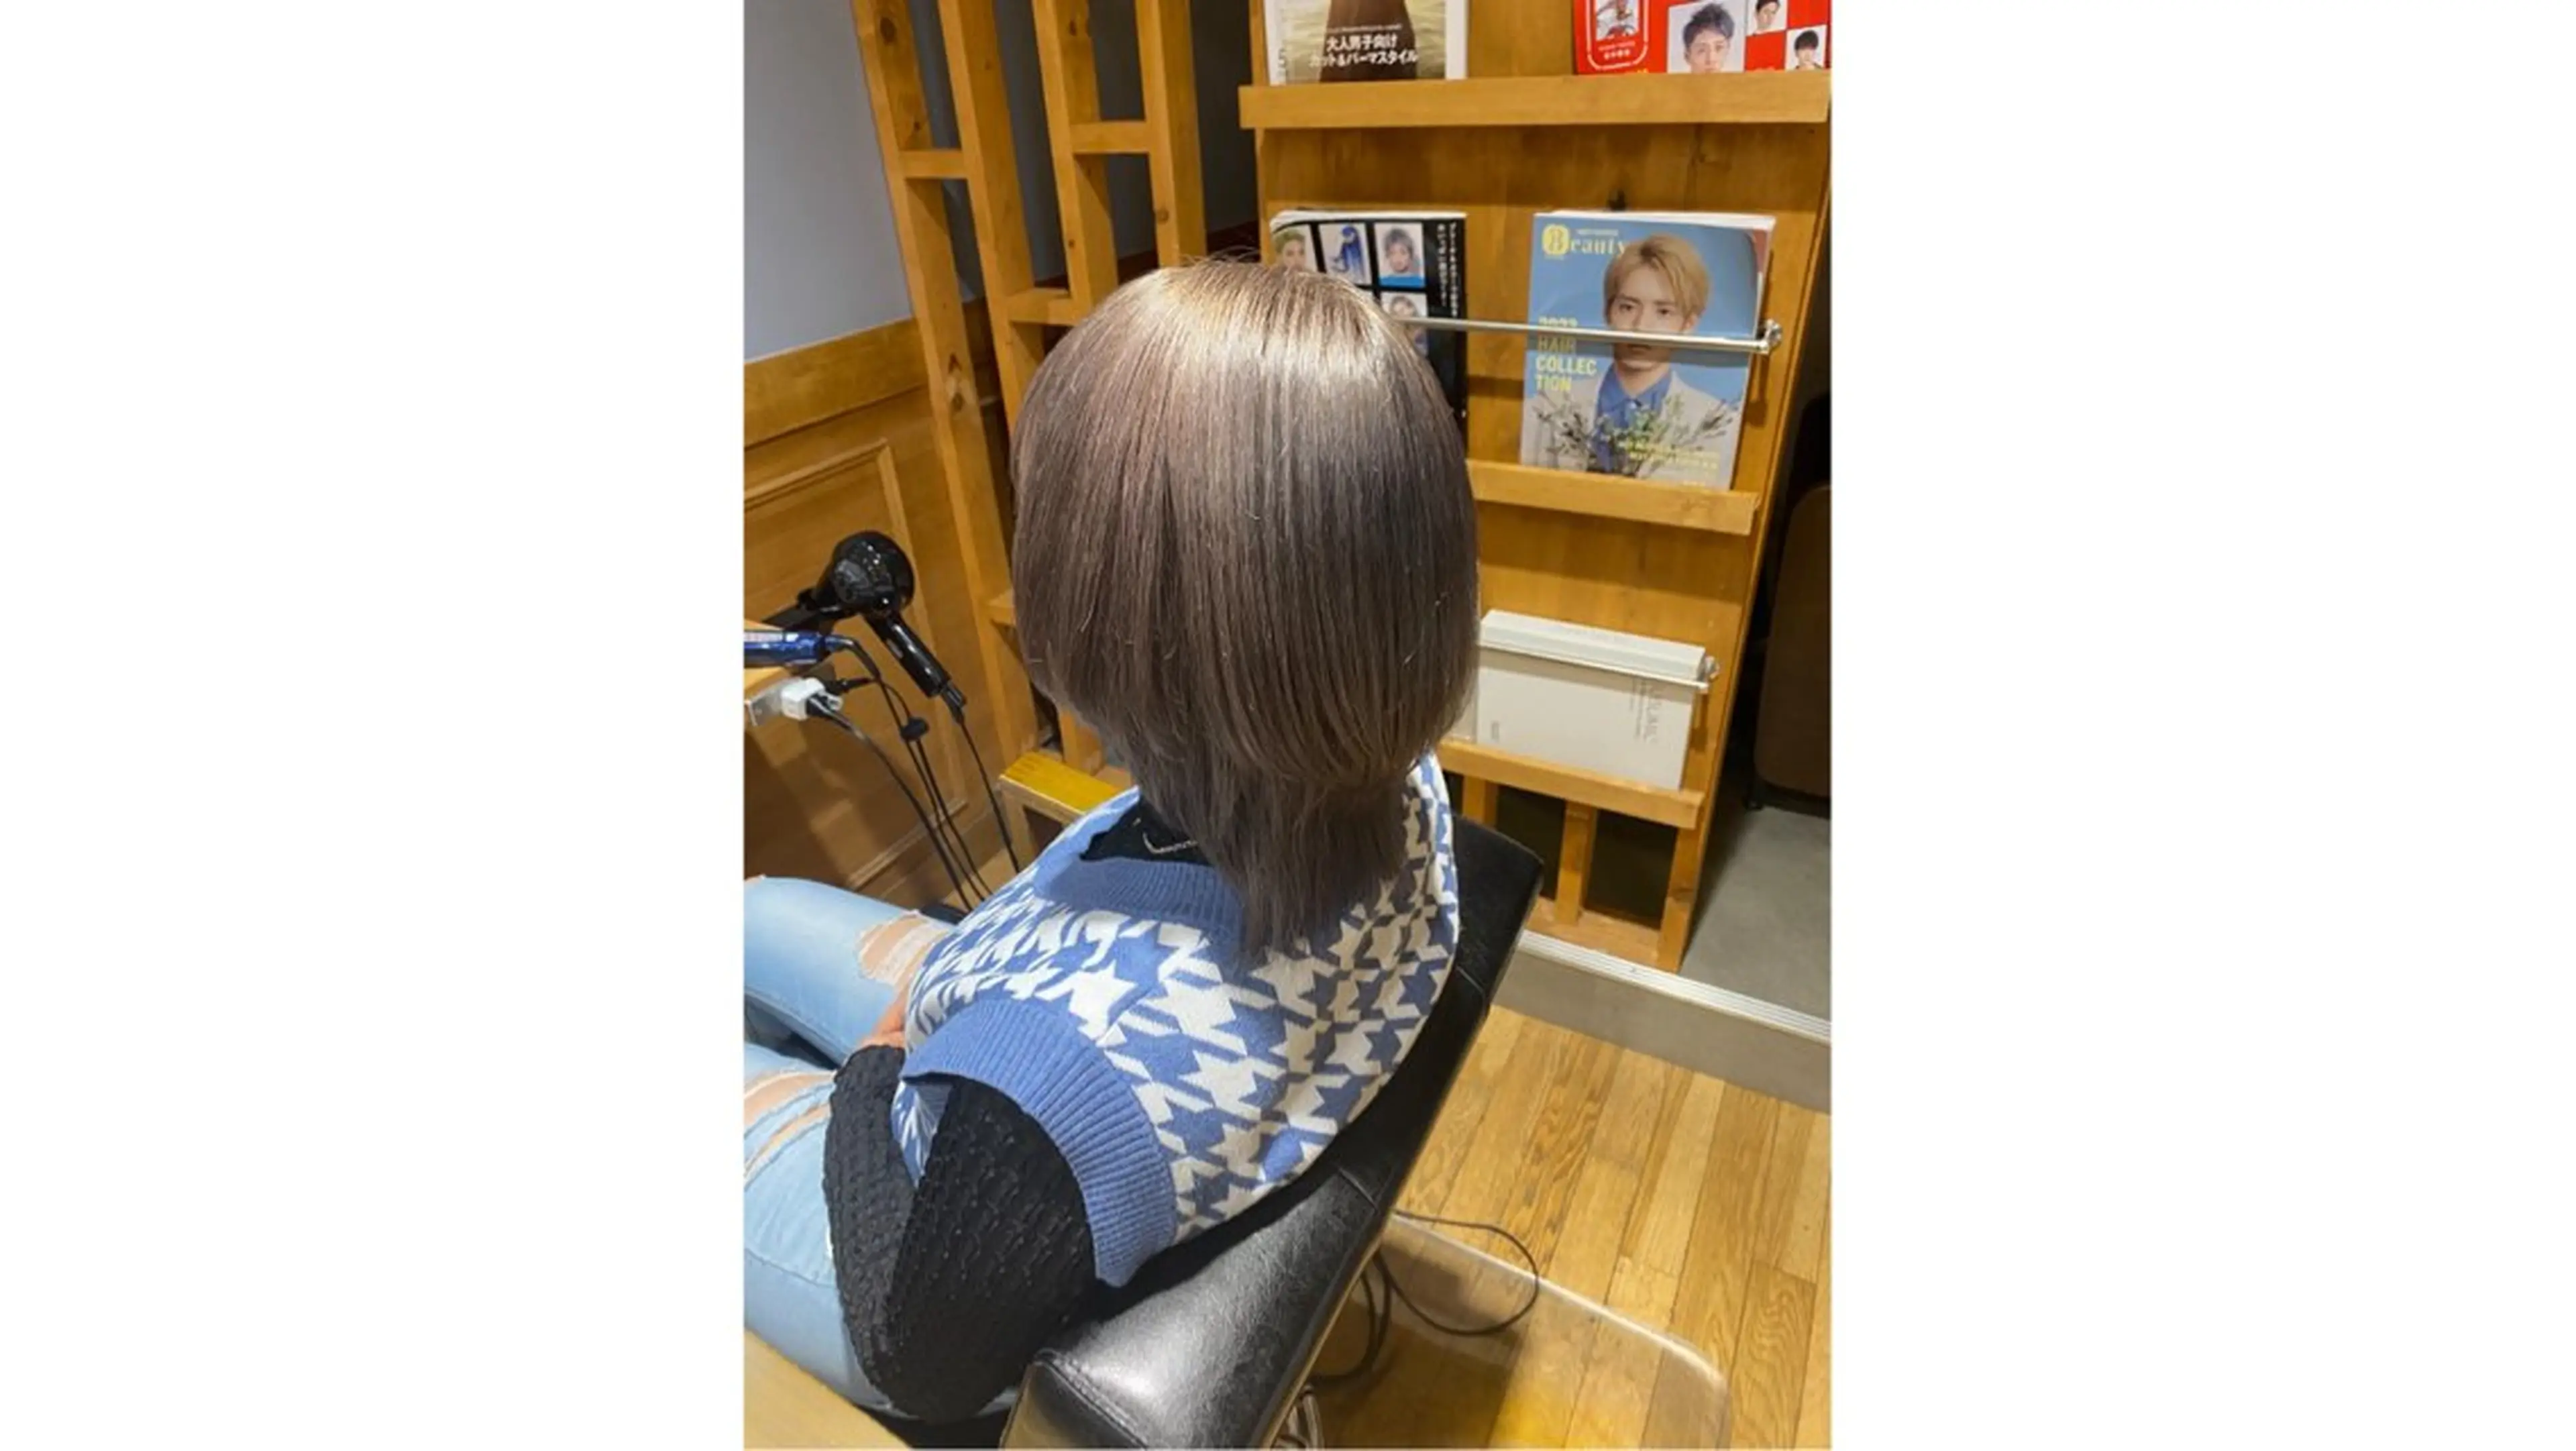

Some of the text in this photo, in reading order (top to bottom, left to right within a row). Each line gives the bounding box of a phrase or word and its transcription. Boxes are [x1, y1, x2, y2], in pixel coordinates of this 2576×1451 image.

[1326, 33, 1397, 52] 大人男子向け
[1536, 356, 1597, 376] COLLEC
[1536, 375, 1572, 392] TION
